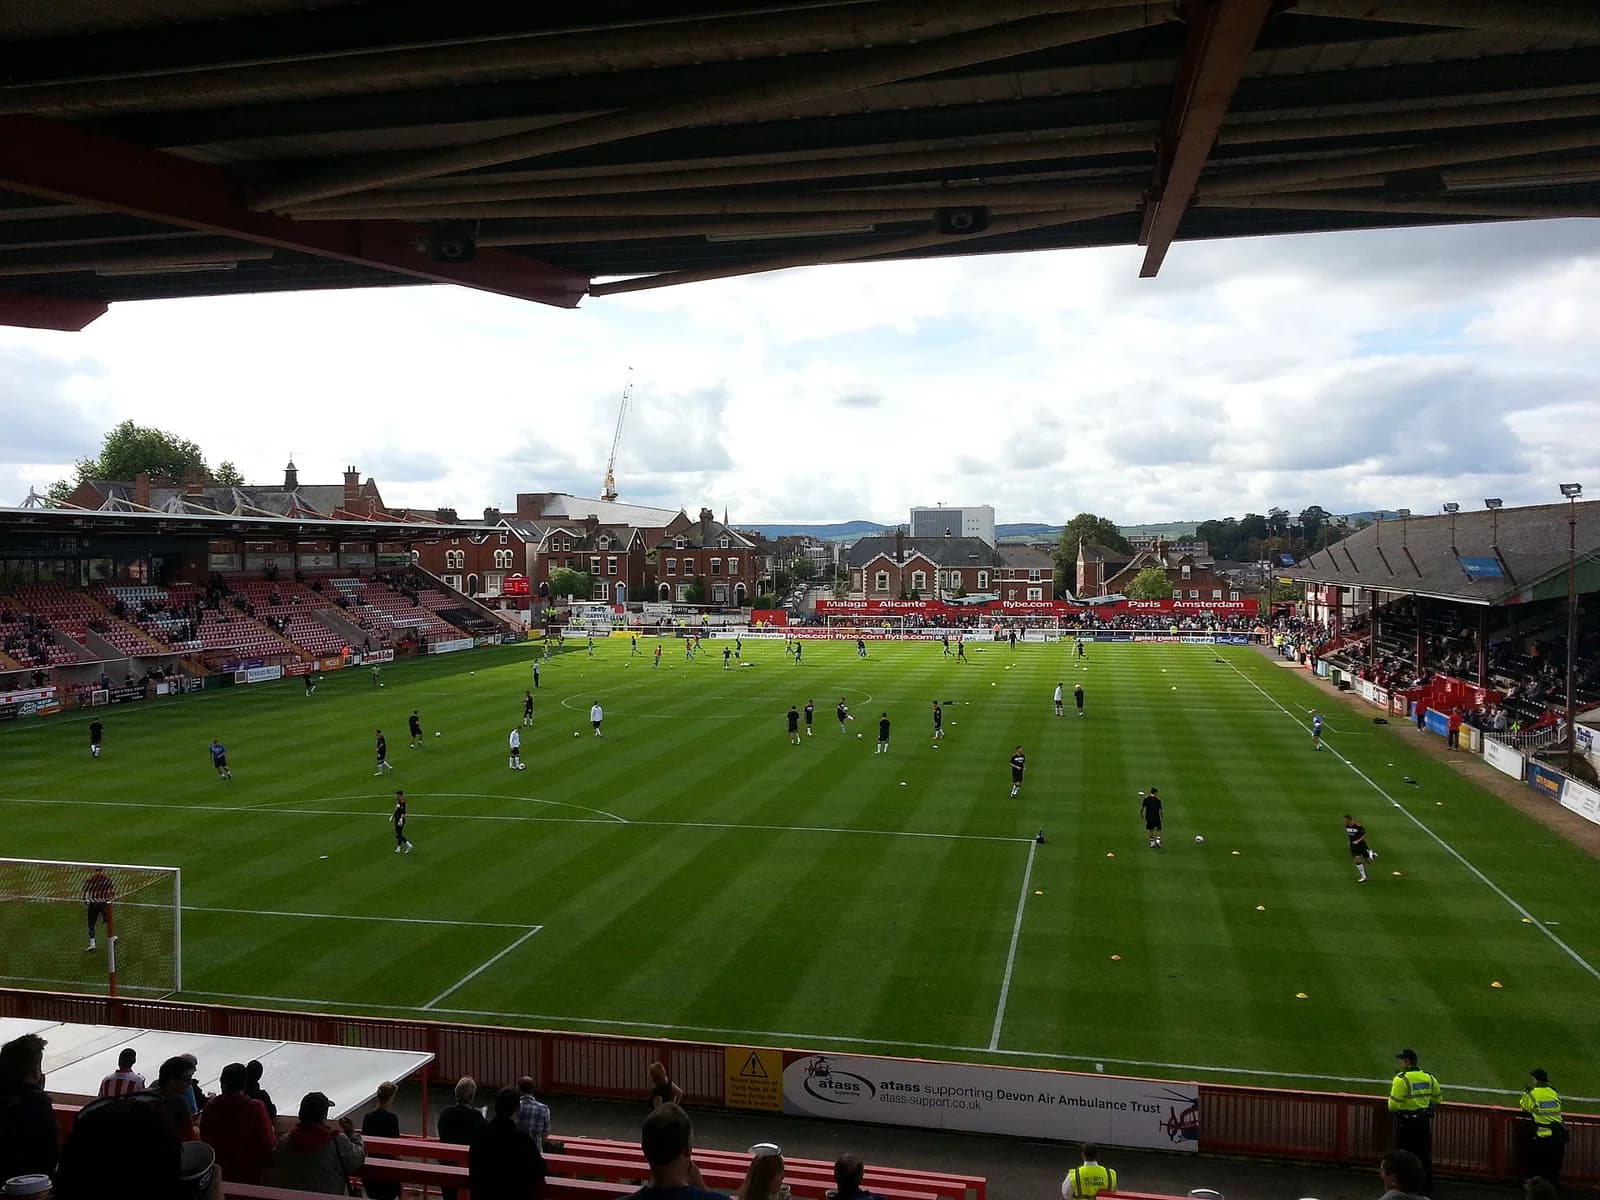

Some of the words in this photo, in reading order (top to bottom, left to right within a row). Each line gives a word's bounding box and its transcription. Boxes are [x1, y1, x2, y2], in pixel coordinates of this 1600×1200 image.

[826, 600, 867, 609] Malaga
[879, 600, 927, 609] Alicante
[1003, 600, 1053, 609] flybe.com
[1128, 600, 1161, 609] Paris
[1173, 600, 1244, 609] Amsterdam
[787, 633, 833, 641] flybe.com
[835, 633, 882, 642] flybe.com
[884, 633, 933, 642] flybe.com
[818, 1080, 860, 1091] atass
[880, 1081, 920, 1092] atass
[924, 1083, 993, 1101] supporting
[997, 1089, 1034, 1103] Devon
[1038, 1092, 1055, 1104] Air
[1059, 1095, 1127, 1111] Ambulance
[1130, 1101, 1161, 1114] Trust
[880, 1093, 981, 1111] atass-support.co.uk
